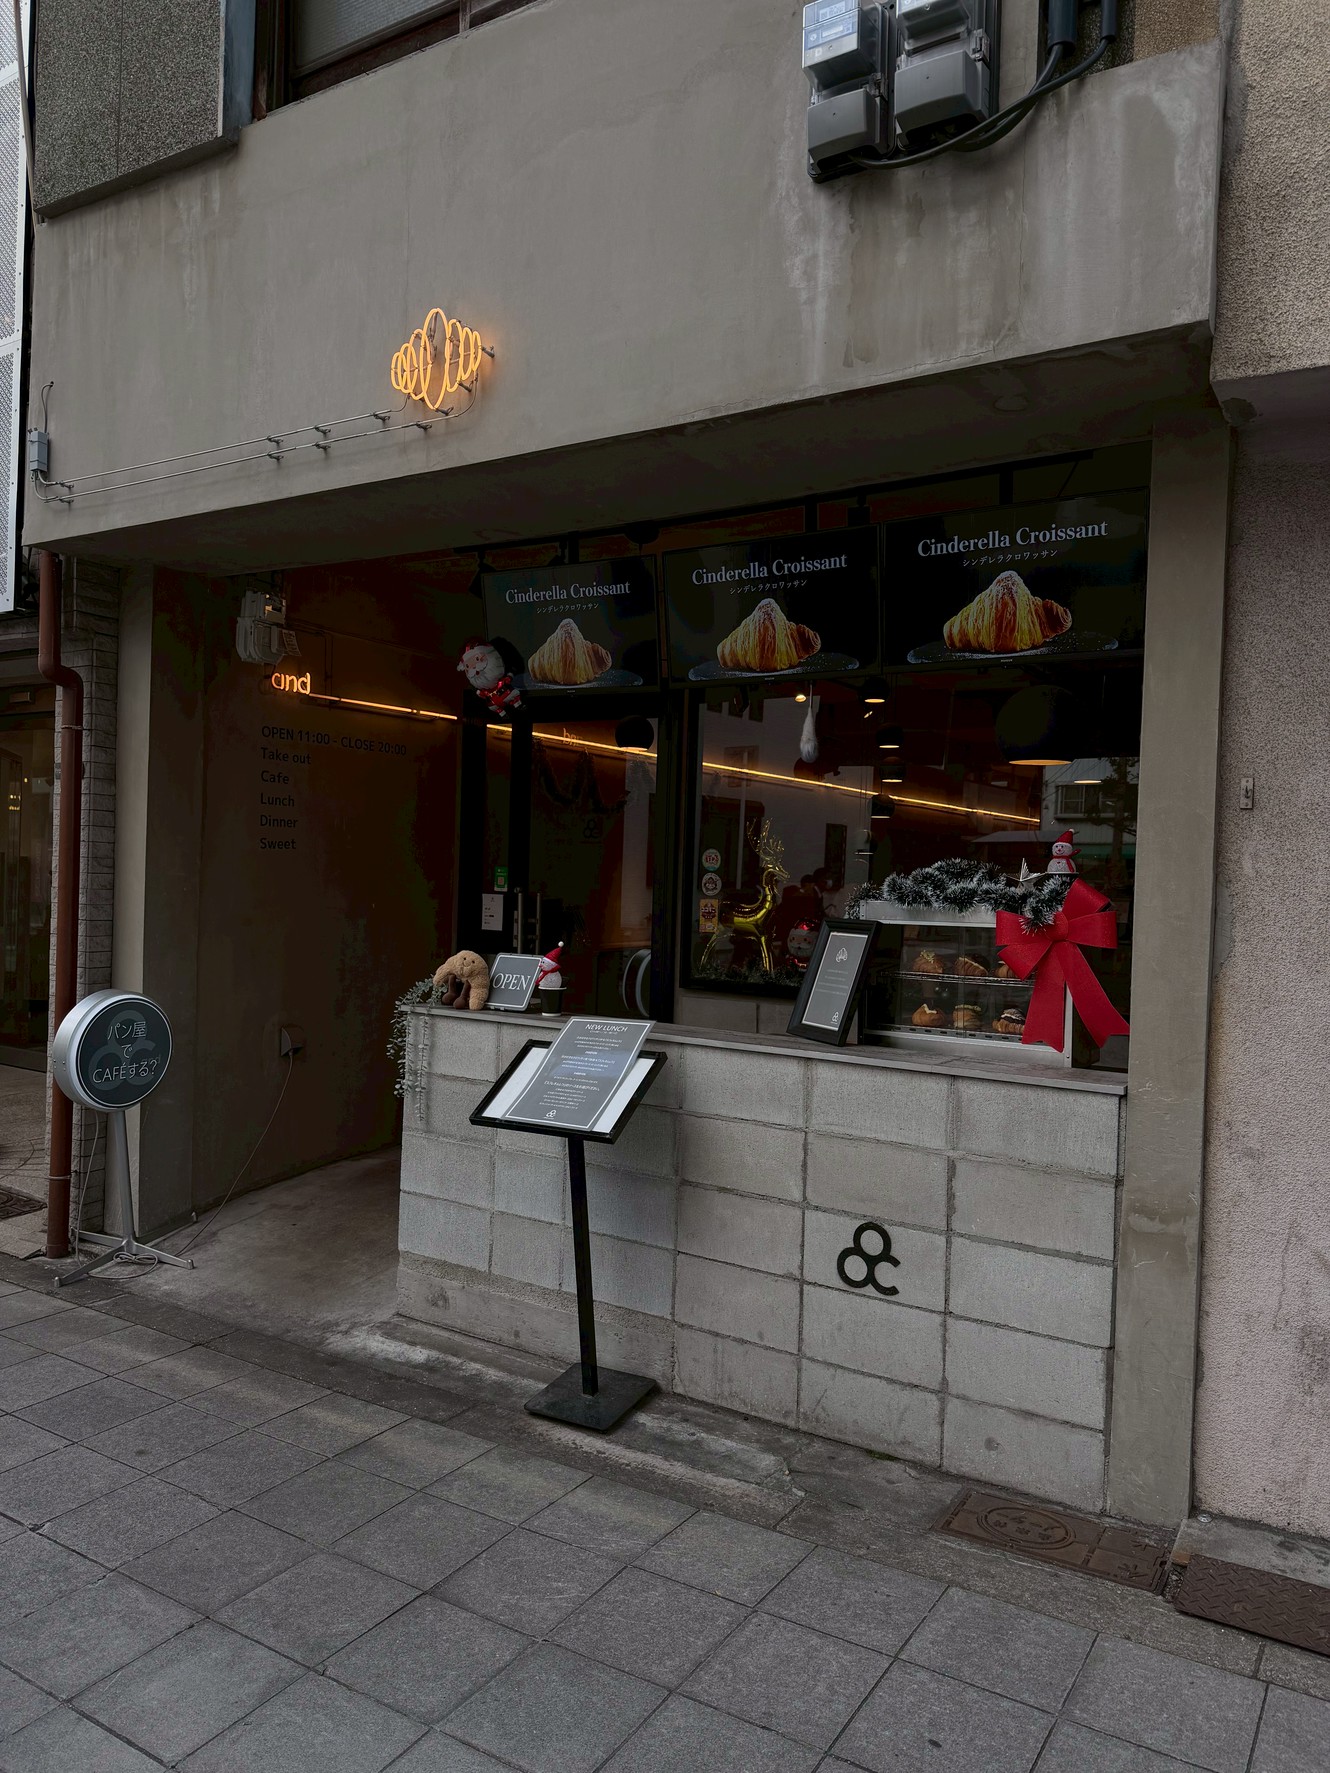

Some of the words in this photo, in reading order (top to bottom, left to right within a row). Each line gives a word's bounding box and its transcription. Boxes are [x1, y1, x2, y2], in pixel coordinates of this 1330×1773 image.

[917, 530, 1011, 557] Cinderella
[1015, 520, 1108, 546] Croissant
[962, 549, 1059, 567] シンデレラクロワッサン
[691, 561, 768, 586] Cinderella
[771, 553, 848, 577] Croissant
[505, 585, 567, 605] Cinderella
[569, 580, 631, 599] Croissant
[729, 578, 808, 595] シンデレラクロワッサン
[536, 602, 599, 614] シンデレラクロワッサン
[271, 672, 310, 694] and
[261, 726, 294, 742] OPEN
[297, 730, 330, 745] 11:00
[341, 736, 375, 752] CLOSE
[378, 740, 407, 756] 20:00
[261, 747, 289, 762] Take
[292, 752, 311, 765] out
[261, 770, 290, 785] Cafe
[260, 792, 295, 807] Lunch
[260, 814, 298, 829] Dinner
[260, 837, 297, 850] Sweet
[492, 972, 531, 991] OPEN
[107, 1021, 147, 1040] パン屋
[584, 1023, 604, 1031] NEW
[602, 1024, 628, 1033] LUNCH
[121, 1043, 134, 1059] で
